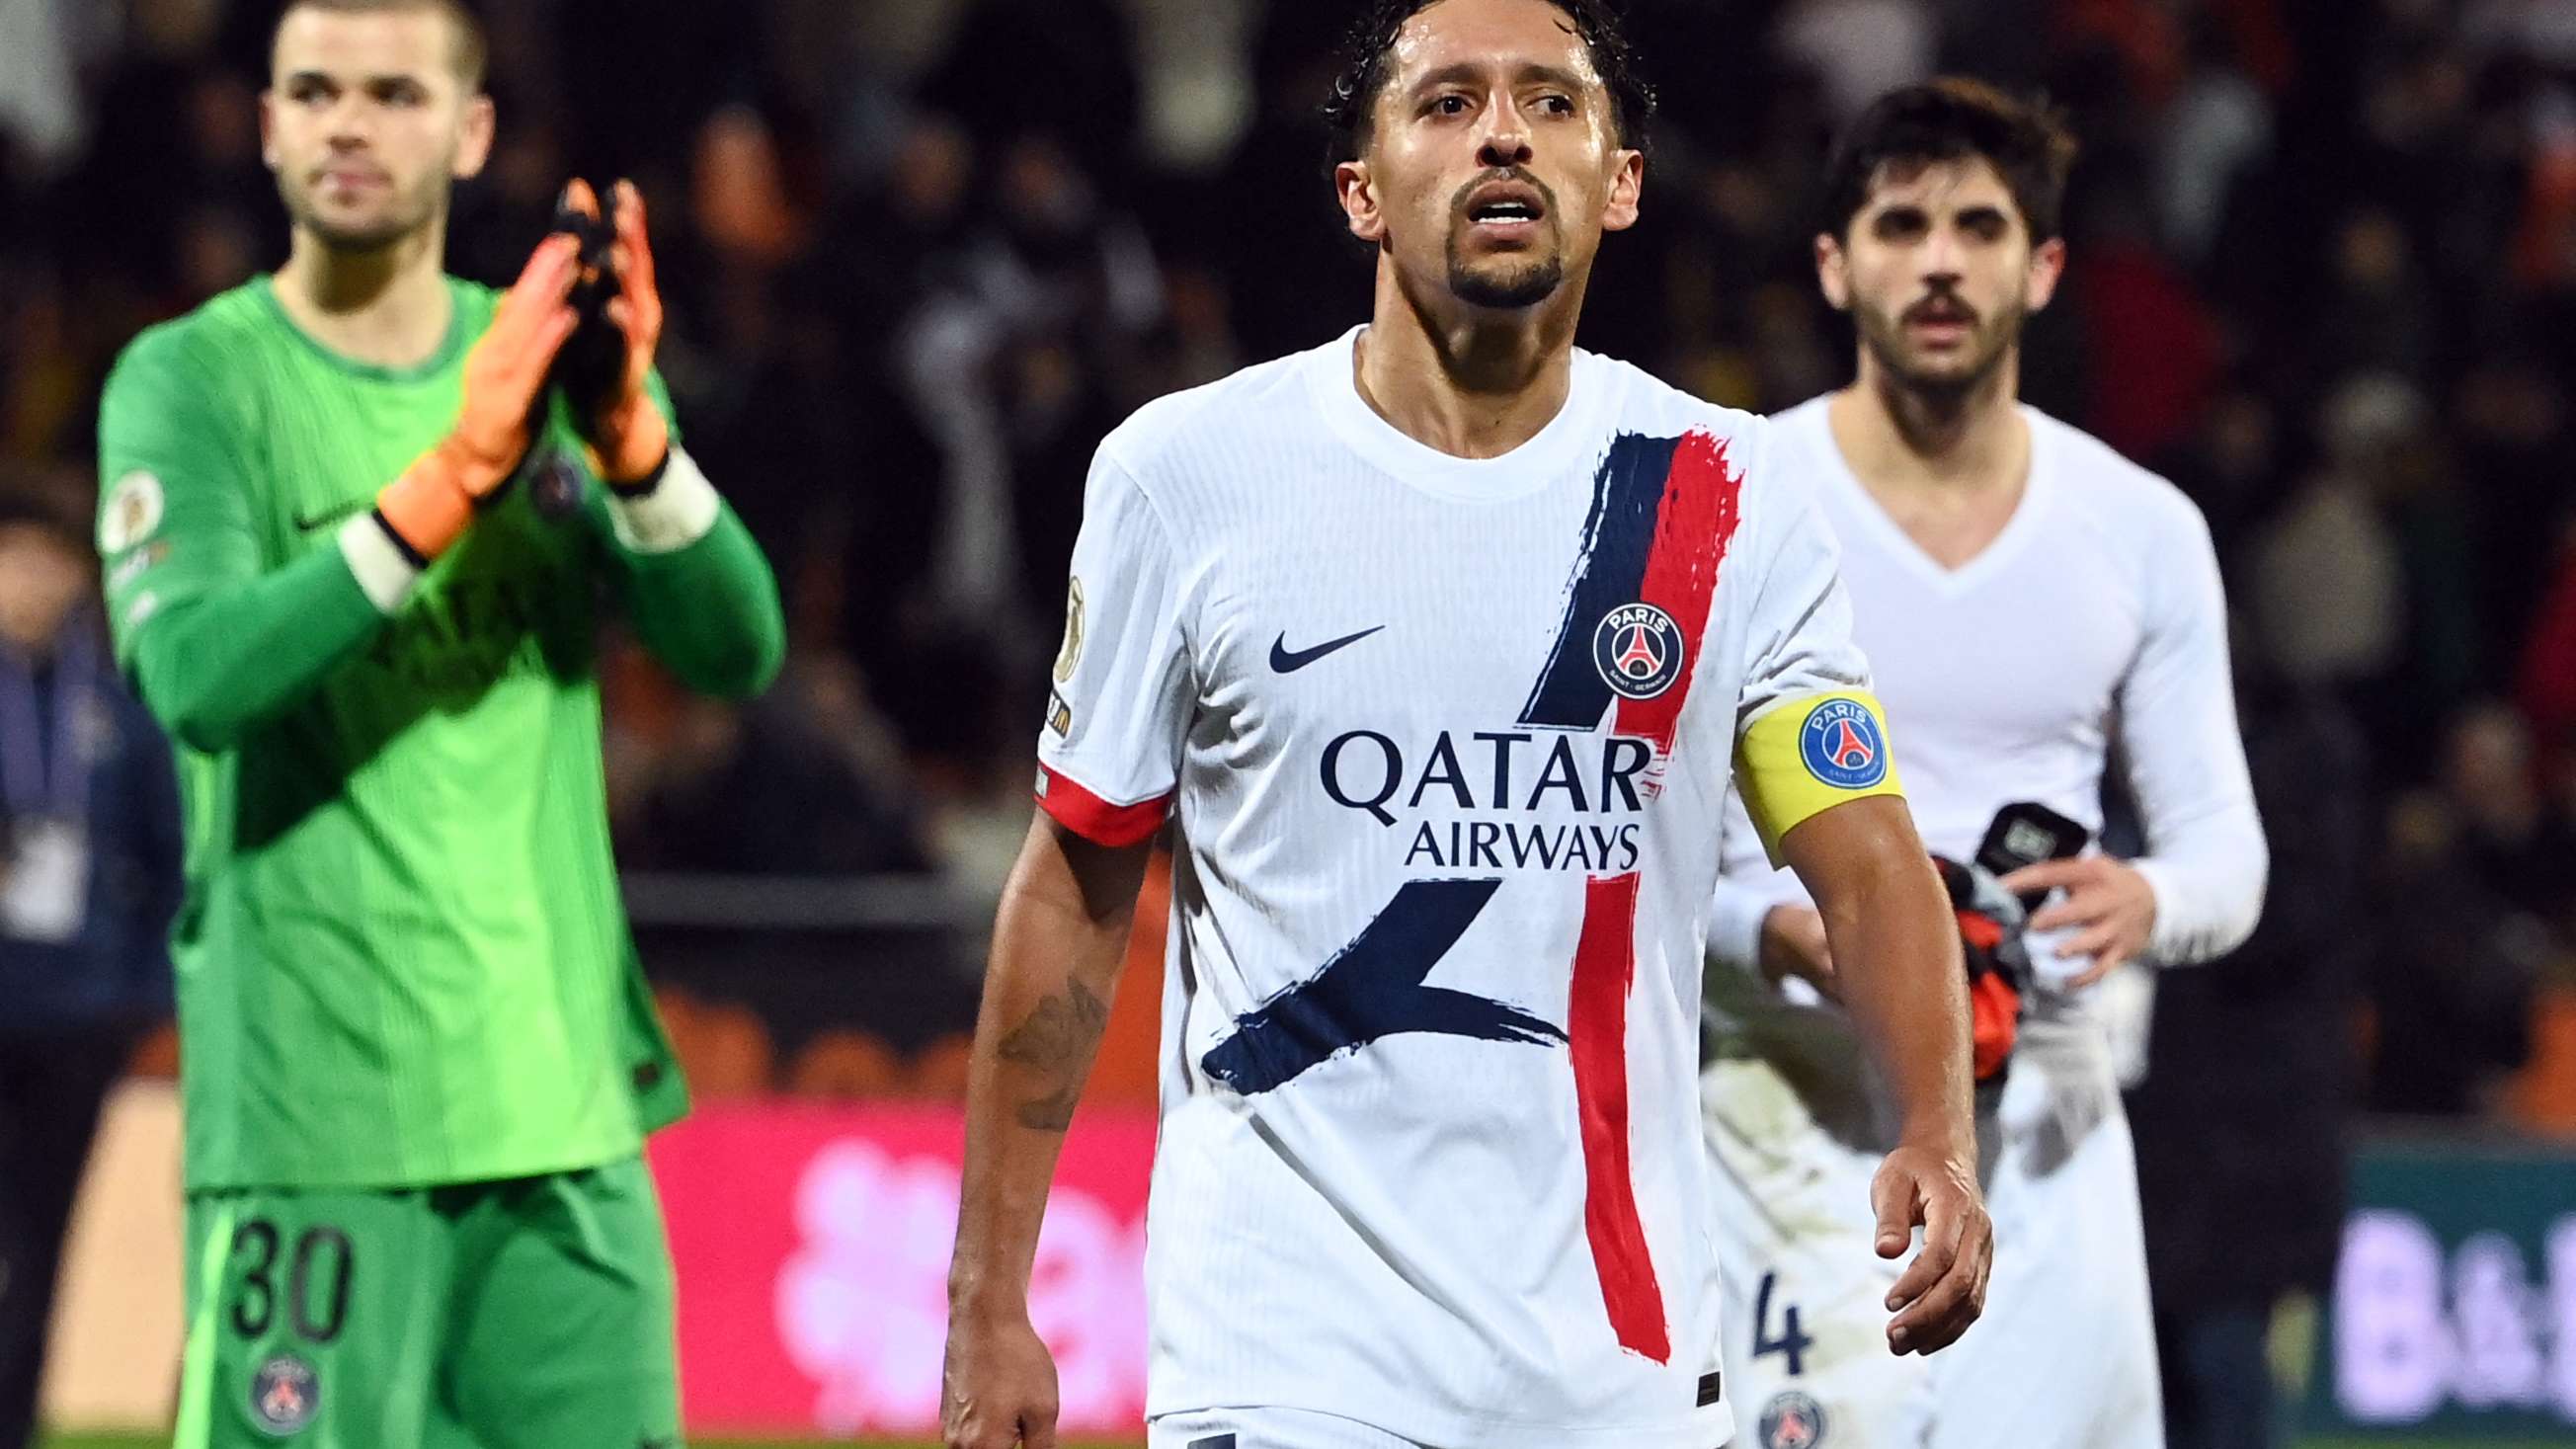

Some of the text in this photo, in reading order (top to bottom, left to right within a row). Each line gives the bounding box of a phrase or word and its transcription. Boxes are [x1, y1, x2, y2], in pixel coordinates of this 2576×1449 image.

[1608, 608, 1668, 632] PARIS
[1811, 704, 1867, 731] PARIS
[1320, 730, 1650, 828] QATAR
[1404, 821, 1640, 870] AIRWAYS
[232, 1220, 355, 1343] 30
[1753, 1271, 1813, 1375] 4
